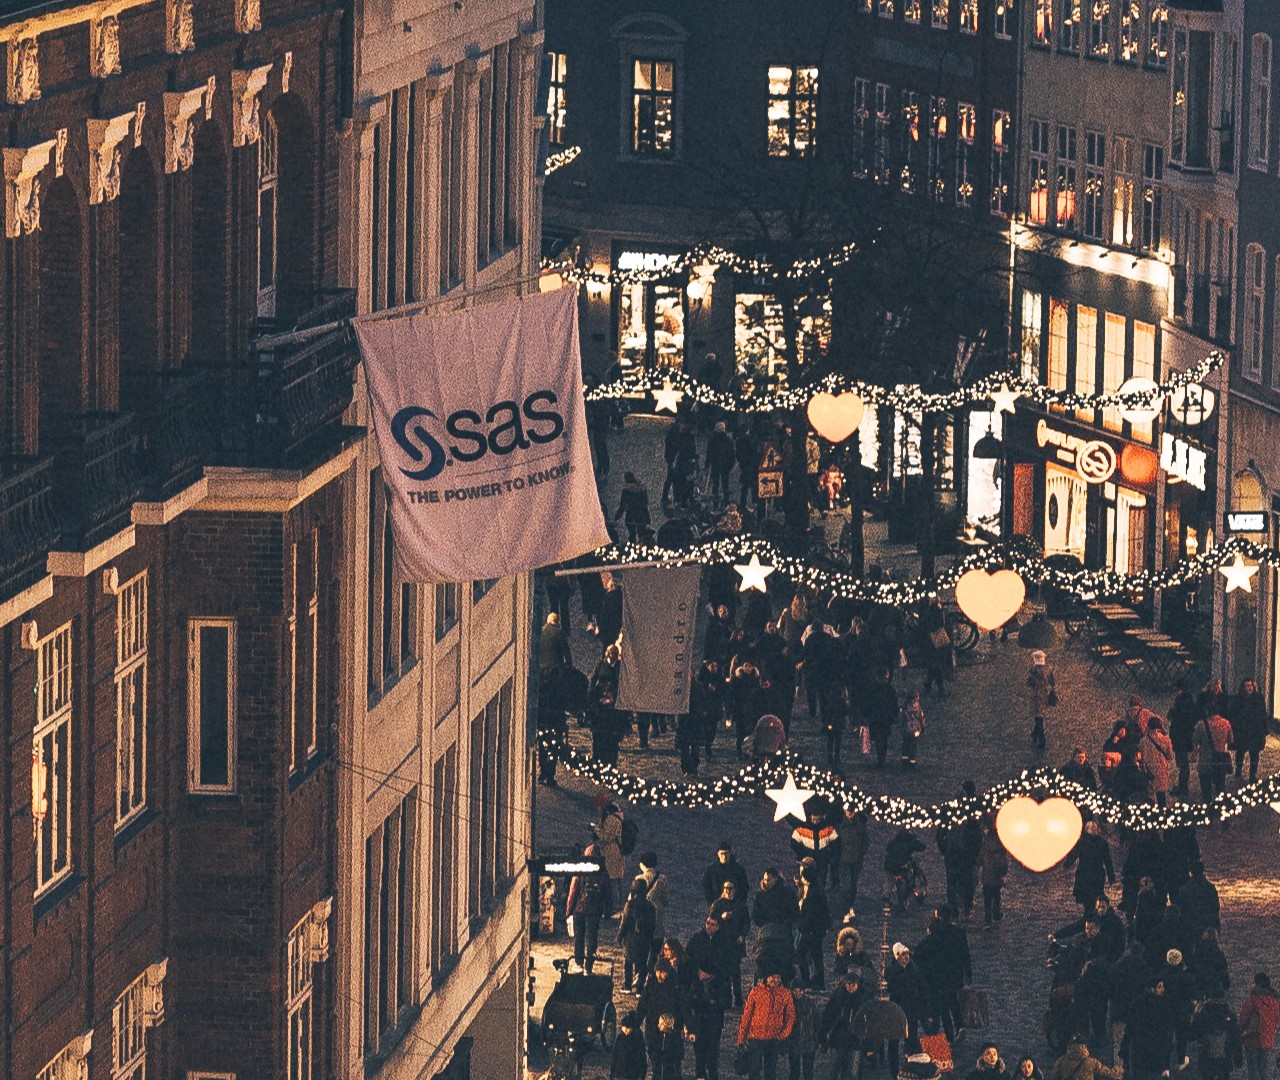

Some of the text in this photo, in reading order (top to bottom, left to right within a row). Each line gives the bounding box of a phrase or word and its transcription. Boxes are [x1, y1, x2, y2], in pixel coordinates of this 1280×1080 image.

[407, 490, 440, 504] THE
[444, 482, 504, 503] POWER
[504, 478, 526, 493] TO
[673, 602, 688, 696] sandro
